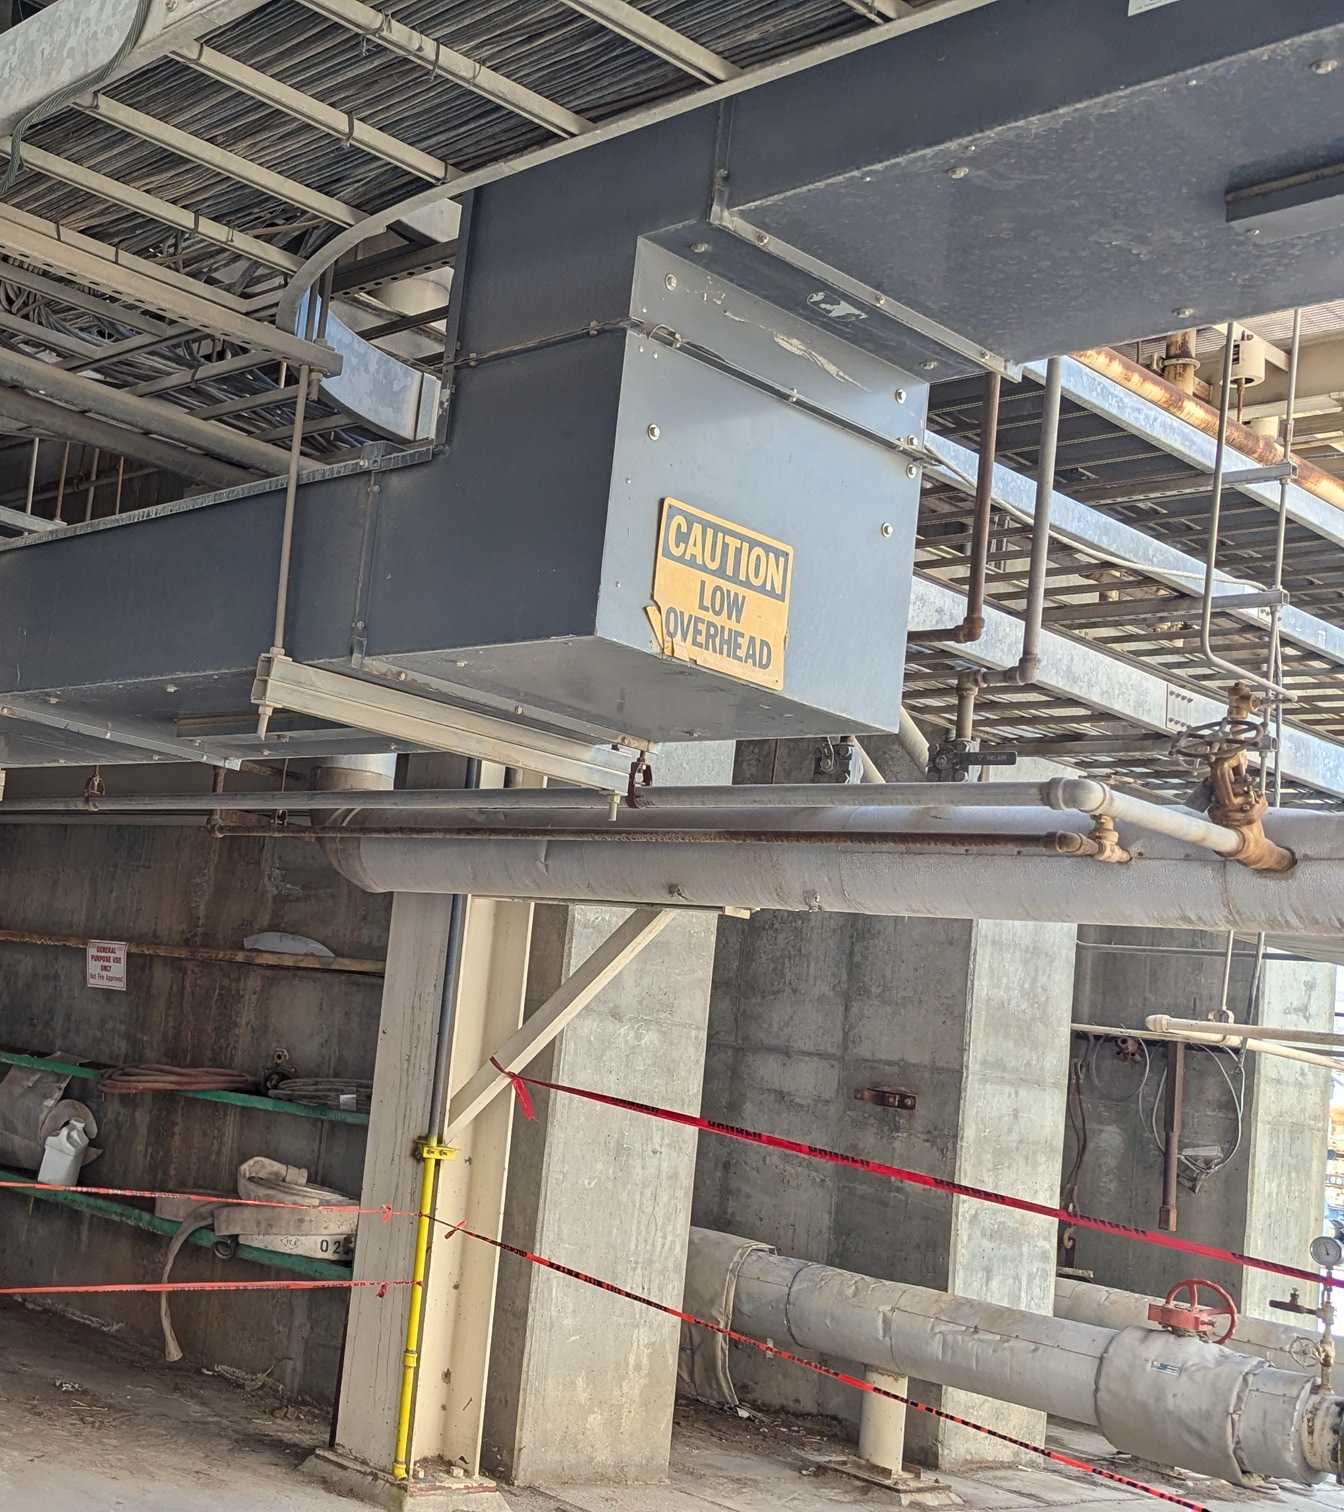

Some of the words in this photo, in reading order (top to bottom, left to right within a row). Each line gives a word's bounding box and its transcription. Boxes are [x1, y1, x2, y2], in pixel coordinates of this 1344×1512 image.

[668, 514, 785, 595] CAUTION
[698, 579, 746, 625] LOW
[664, 606, 772, 670] OVERHEAD
